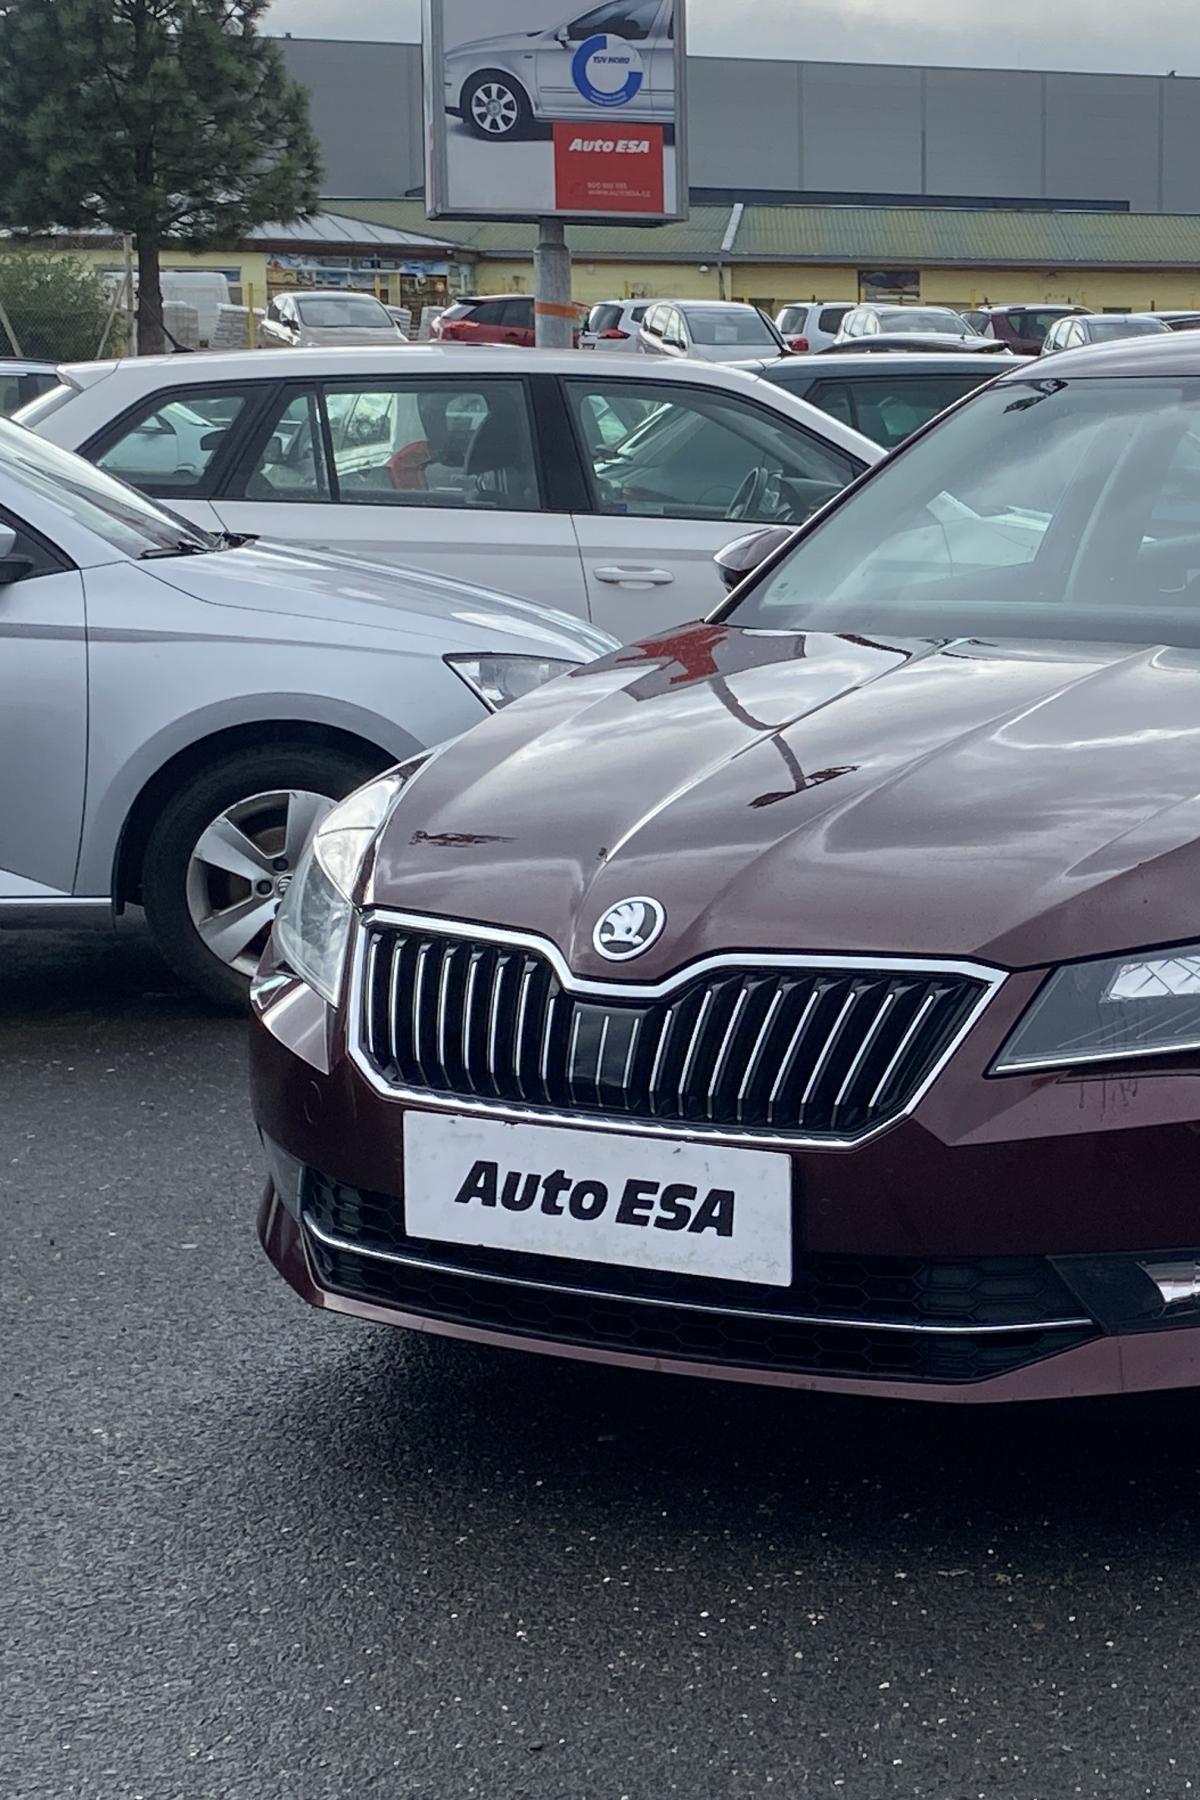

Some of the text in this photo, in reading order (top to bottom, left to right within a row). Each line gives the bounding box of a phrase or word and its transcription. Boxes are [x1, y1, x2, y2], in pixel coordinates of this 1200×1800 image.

[568, 138, 650, 154] Auto ESA
[454, 1160, 735, 1238] Auto ESA
